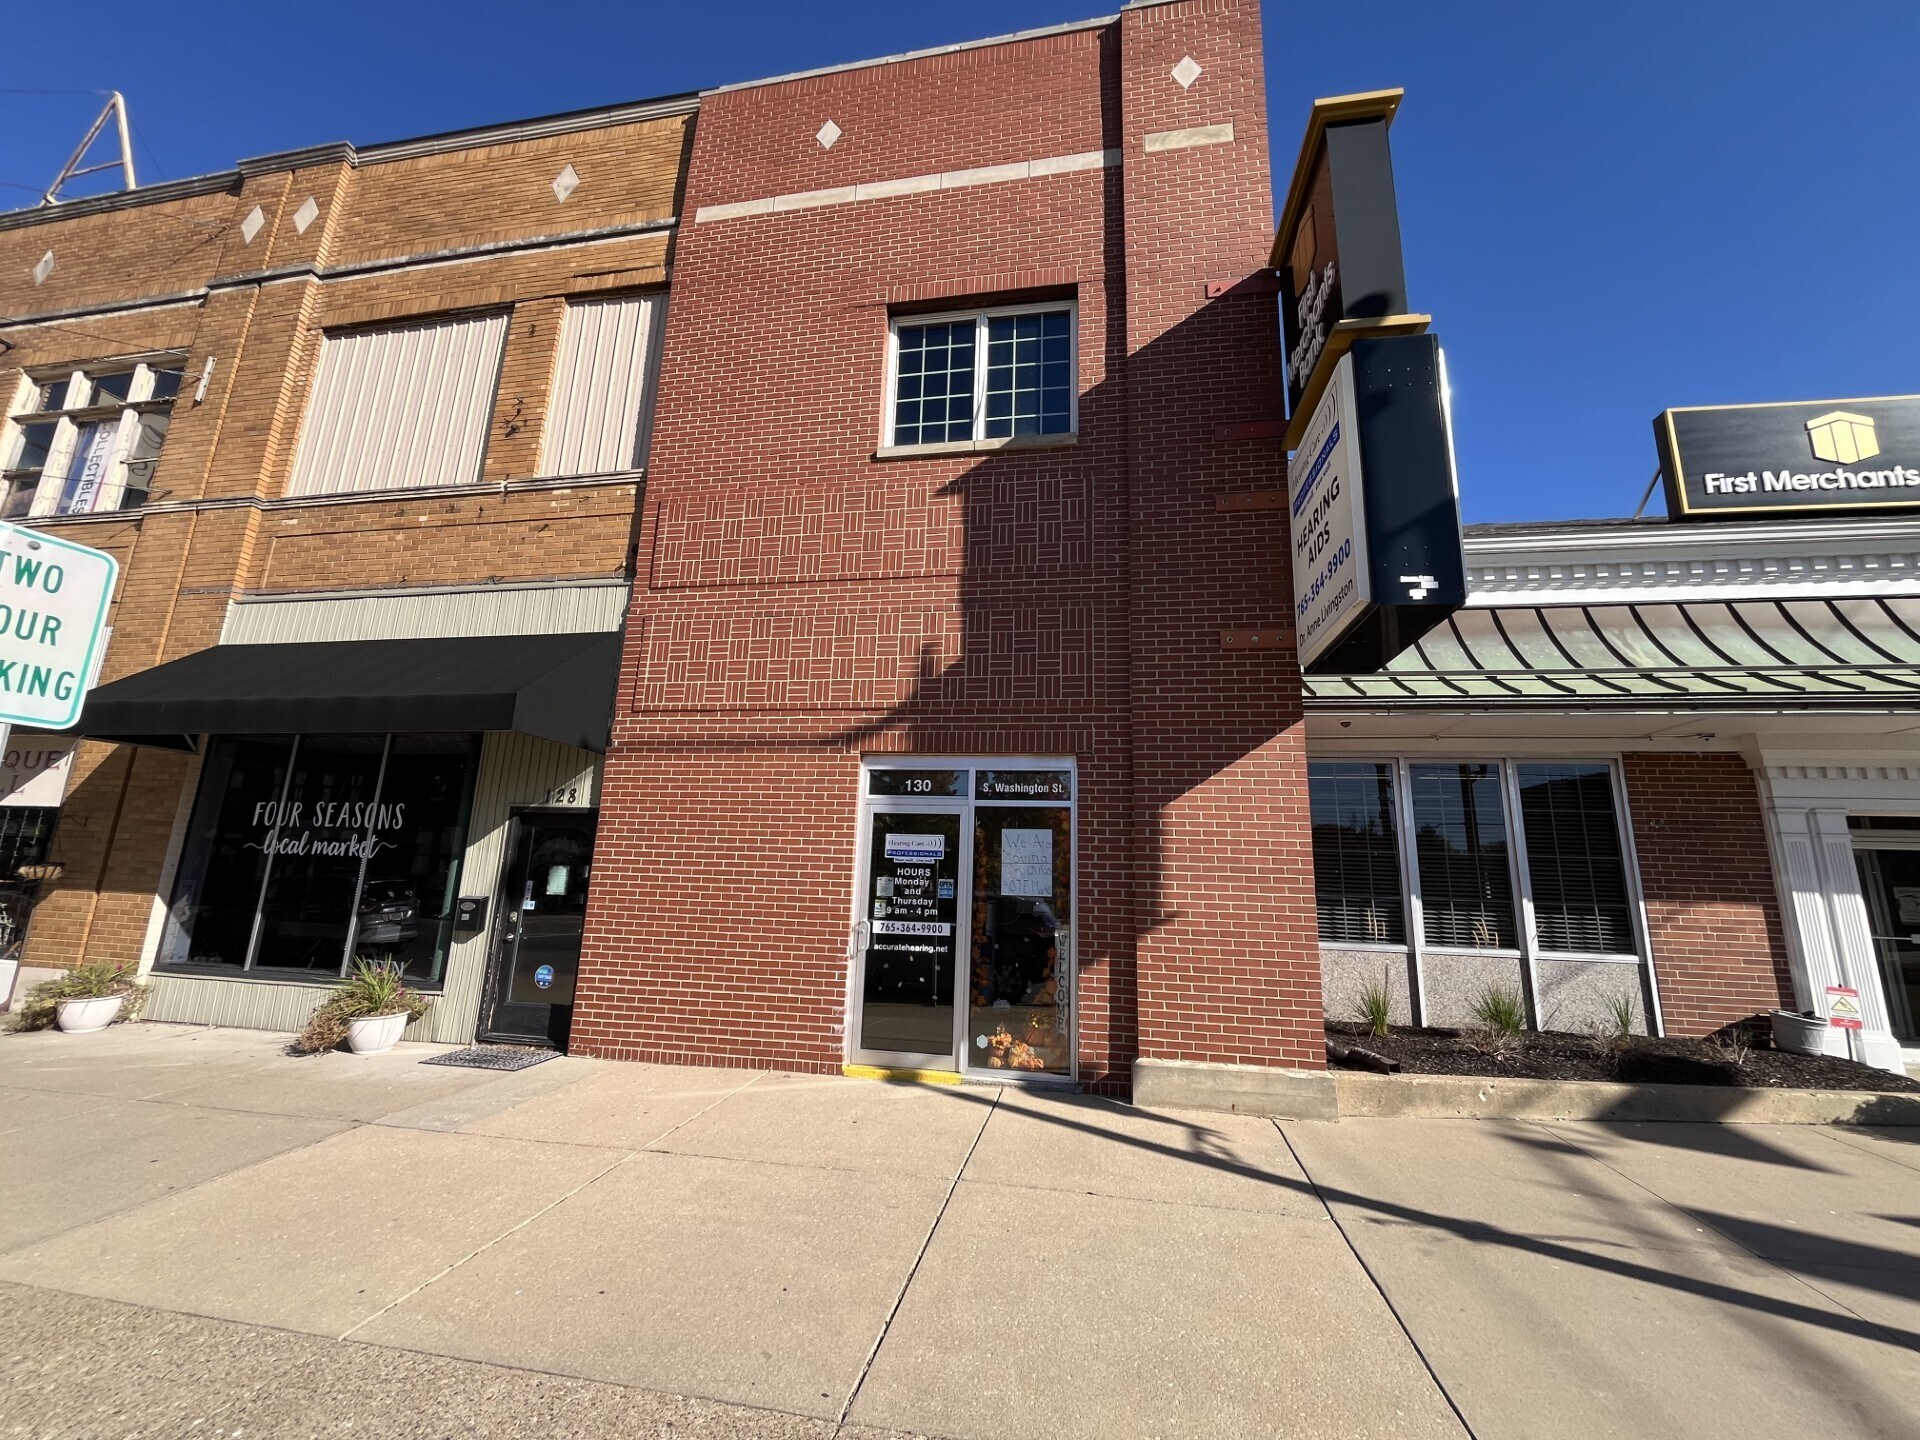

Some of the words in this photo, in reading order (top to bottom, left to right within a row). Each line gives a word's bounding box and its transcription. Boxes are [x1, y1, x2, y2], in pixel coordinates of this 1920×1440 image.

[1300, 322, 1325, 389] Bank
[71, 421, 115, 514] COLLECTIBLES
[1704, 471, 1757, 495] First
[1761, 465, 1920, 492] Merchants
[1297, 475, 1340, 558] HEARING
[1308, 520, 1331, 569] AIDS
[0, 551, 64, 594] TWO
[1297, 537, 1351, 621] 765-364-9900
[1307, 617, 1321, 637] Anne
[1321, 579, 1354, 622] Livingston
[545, 787, 577, 804] 128
[905, 779, 932, 792] 130
[983, 783, 992, 793] S.
[995, 782, 1049, 795] Washington
[1052, 784, 1065, 793] St.
[252, 801, 303, 828] FOUR
[313, 801, 405, 829] SEASONS
[262, 829, 310, 855] local
[311, 834, 379, 859] market
[1004, 833, 1027, 848] We
[894, 877, 930, 888] Monday
[897, 867, 931, 877] HOURS
[886, 906, 892, 914] 9
[916, 907, 922, 915] 4
[924, 908, 938, 917] pm
[892, 896, 934, 908] Thursday
[880, 923, 943, 934] 765-364-9900
[873, 943, 949, 954] accuratehearing.net
[1057, 934, 1067, 1031] WELCOME
